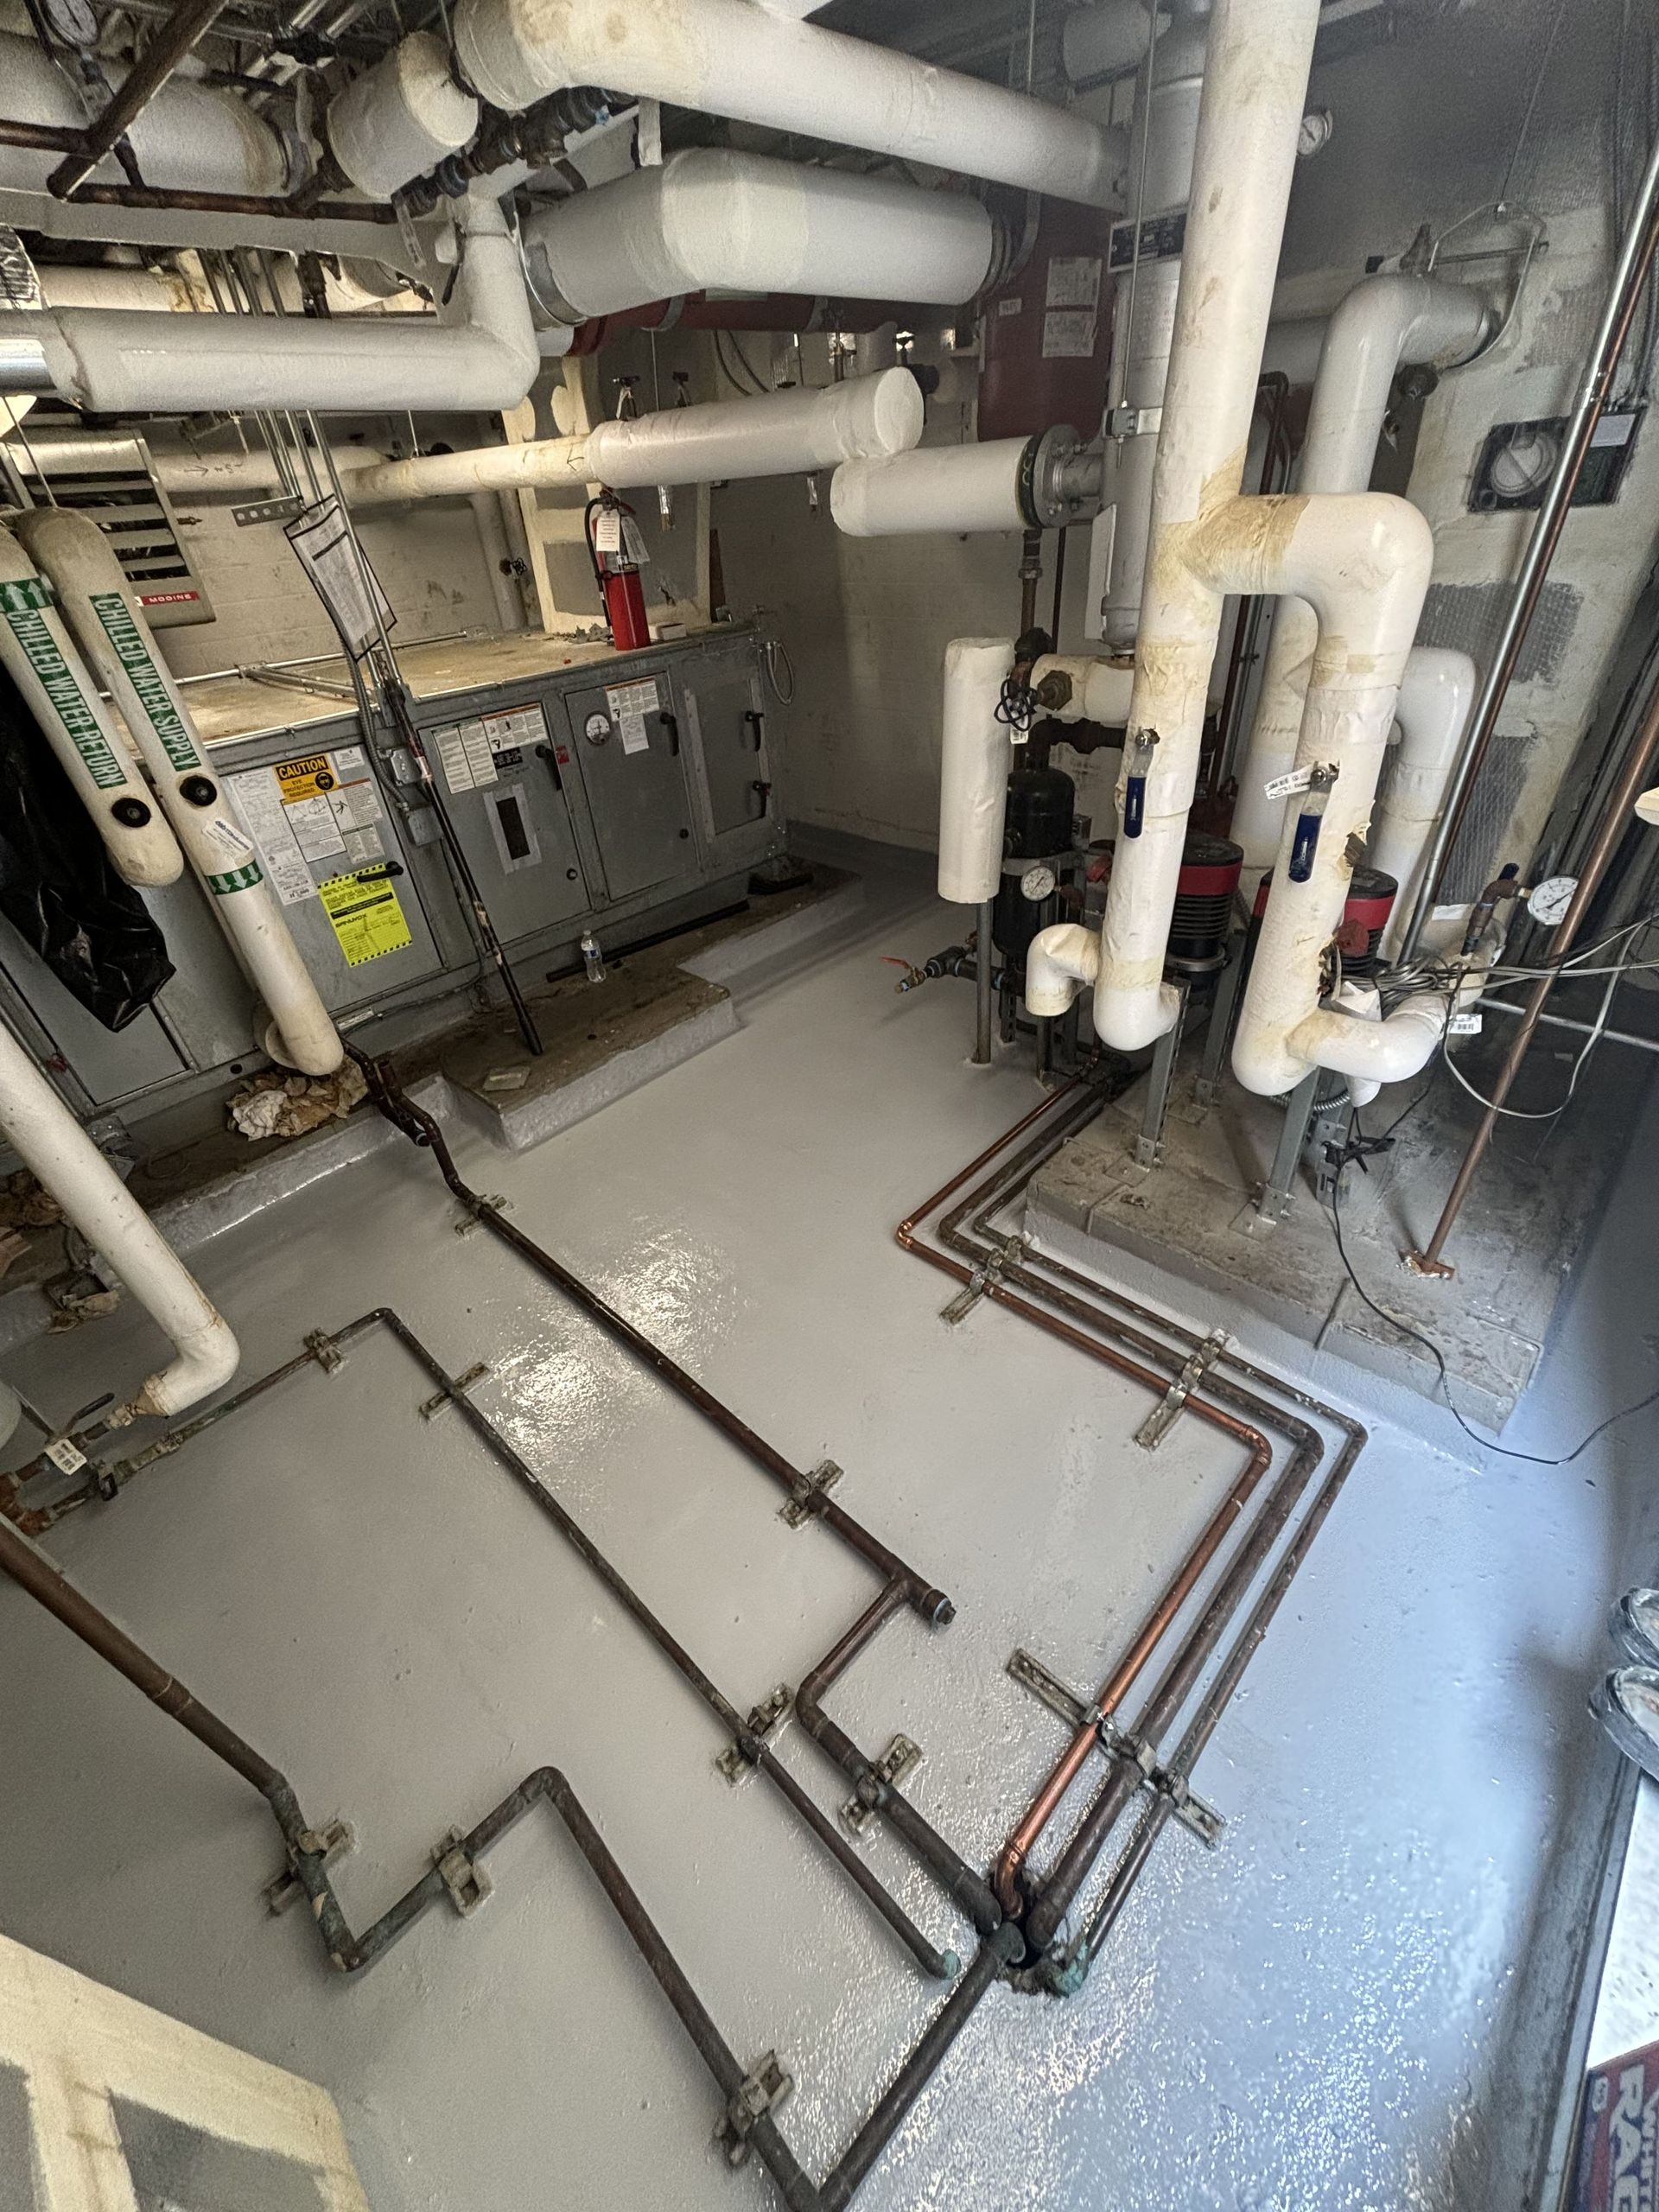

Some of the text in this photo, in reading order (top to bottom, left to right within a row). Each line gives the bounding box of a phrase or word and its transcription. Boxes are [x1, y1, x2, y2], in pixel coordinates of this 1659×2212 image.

[149, 594, 192, 603] MODINE
[7, 609, 125, 788] CHILLED WATER RETURN
[94, 597, 200, 766] CHILLED WATER SUPPLY
[278, 757, 326, 779] CAUTION
